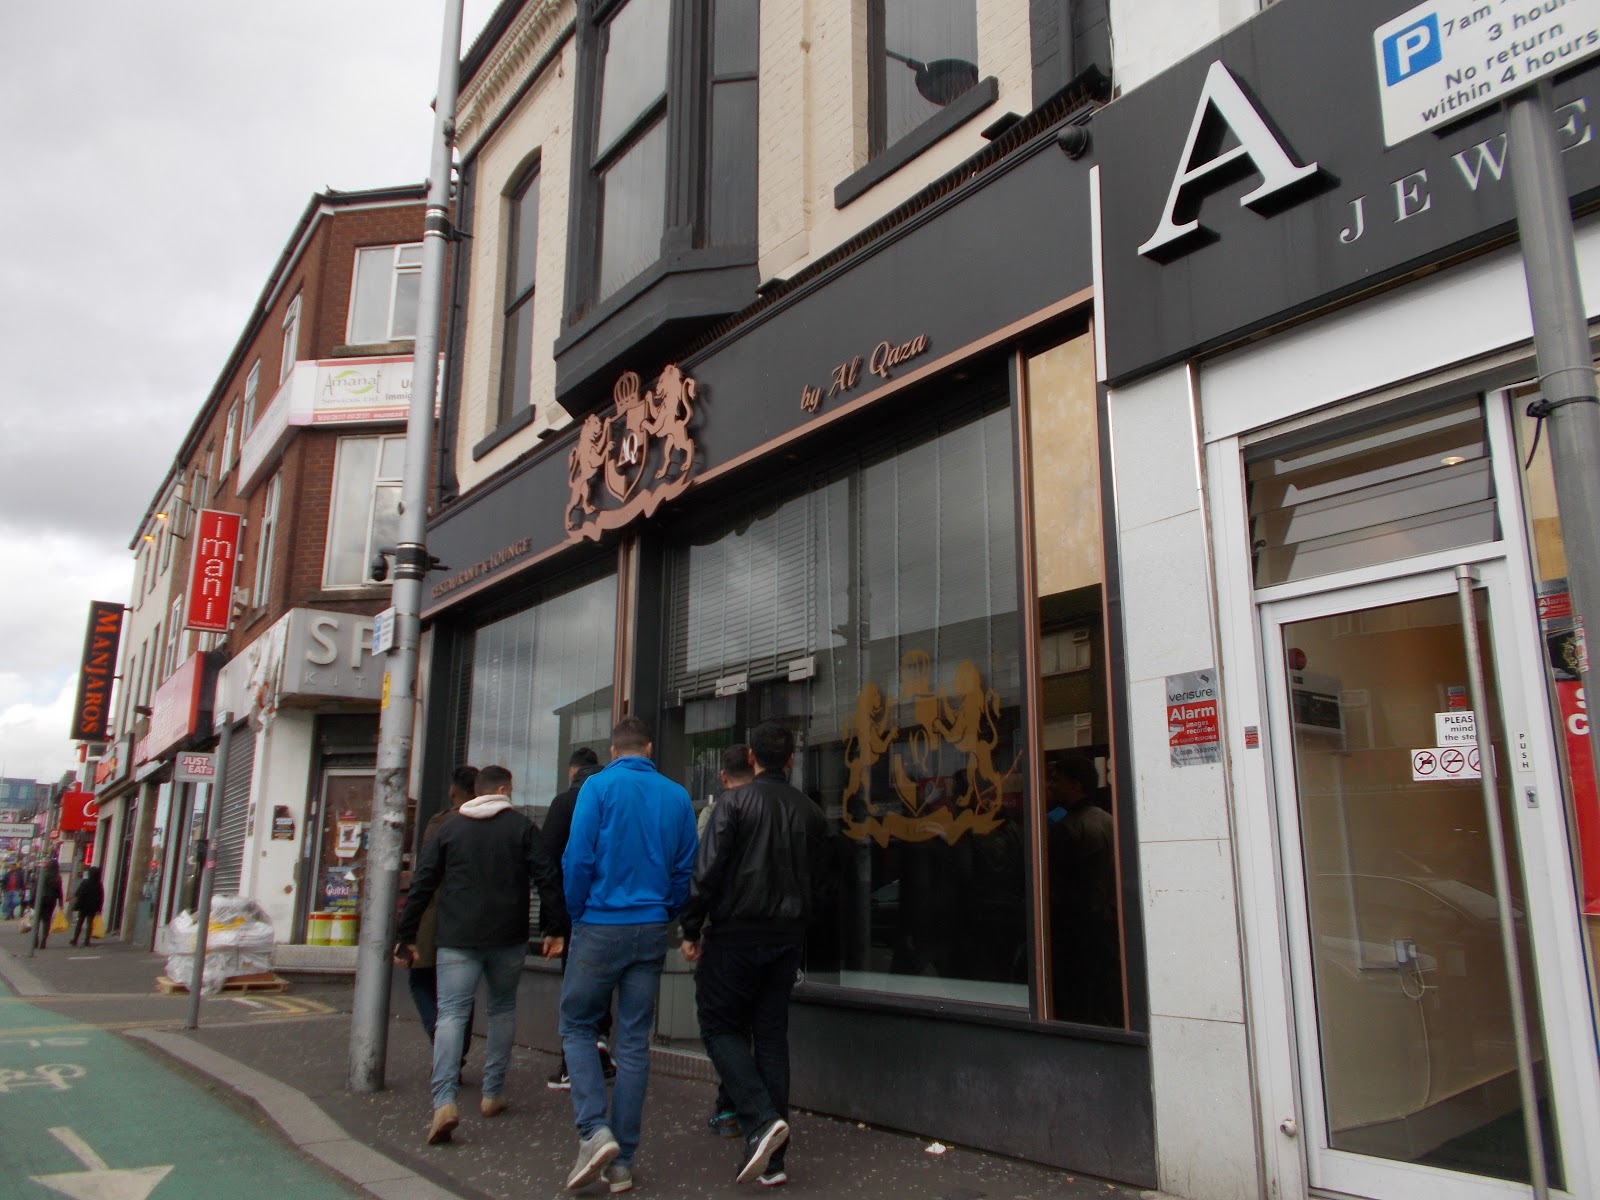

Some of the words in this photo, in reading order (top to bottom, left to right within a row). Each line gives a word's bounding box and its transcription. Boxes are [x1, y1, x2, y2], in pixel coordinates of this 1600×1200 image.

[1443, 5, 1491, 38] 7am
[1487, 23, 1503, 42] 3
[1397, 25, 1431, 77] P
[1446, 65, 1477, 89] No
[1486, 22, 1564, 70] return
[1421, 80, 1491, 122] within
[1500, 64, 1517, 84] 4
[1526, 28, 1599, 74] hours
[1138, 59, 1317, 256] A
[321, 369, 382, 397] Amanat
[800, 384, 822, 413] by
[828, 355, 861, 397] Al
[869, 334, 927, 378] Qaza
[201, 516, 231, 620] imani
[81, 608, 120, 733] MANJAROS
[1168, 688, 1213, 702] verisure
[1170, 705, 1215, 722] Alarm
[1186, 720, 1209, 729] images
[1445, 715, 1475, 724] PLEAS
[1186, 725, 1215, 735] recorded
[1450, 724, 1474, 733] mind
[1462, 732, 1477, 741] ste
[182, 756, 209, 766] JUST
[1519, 733, 1530, 768] PUSH
[187, 765, 207, 775] EAT
